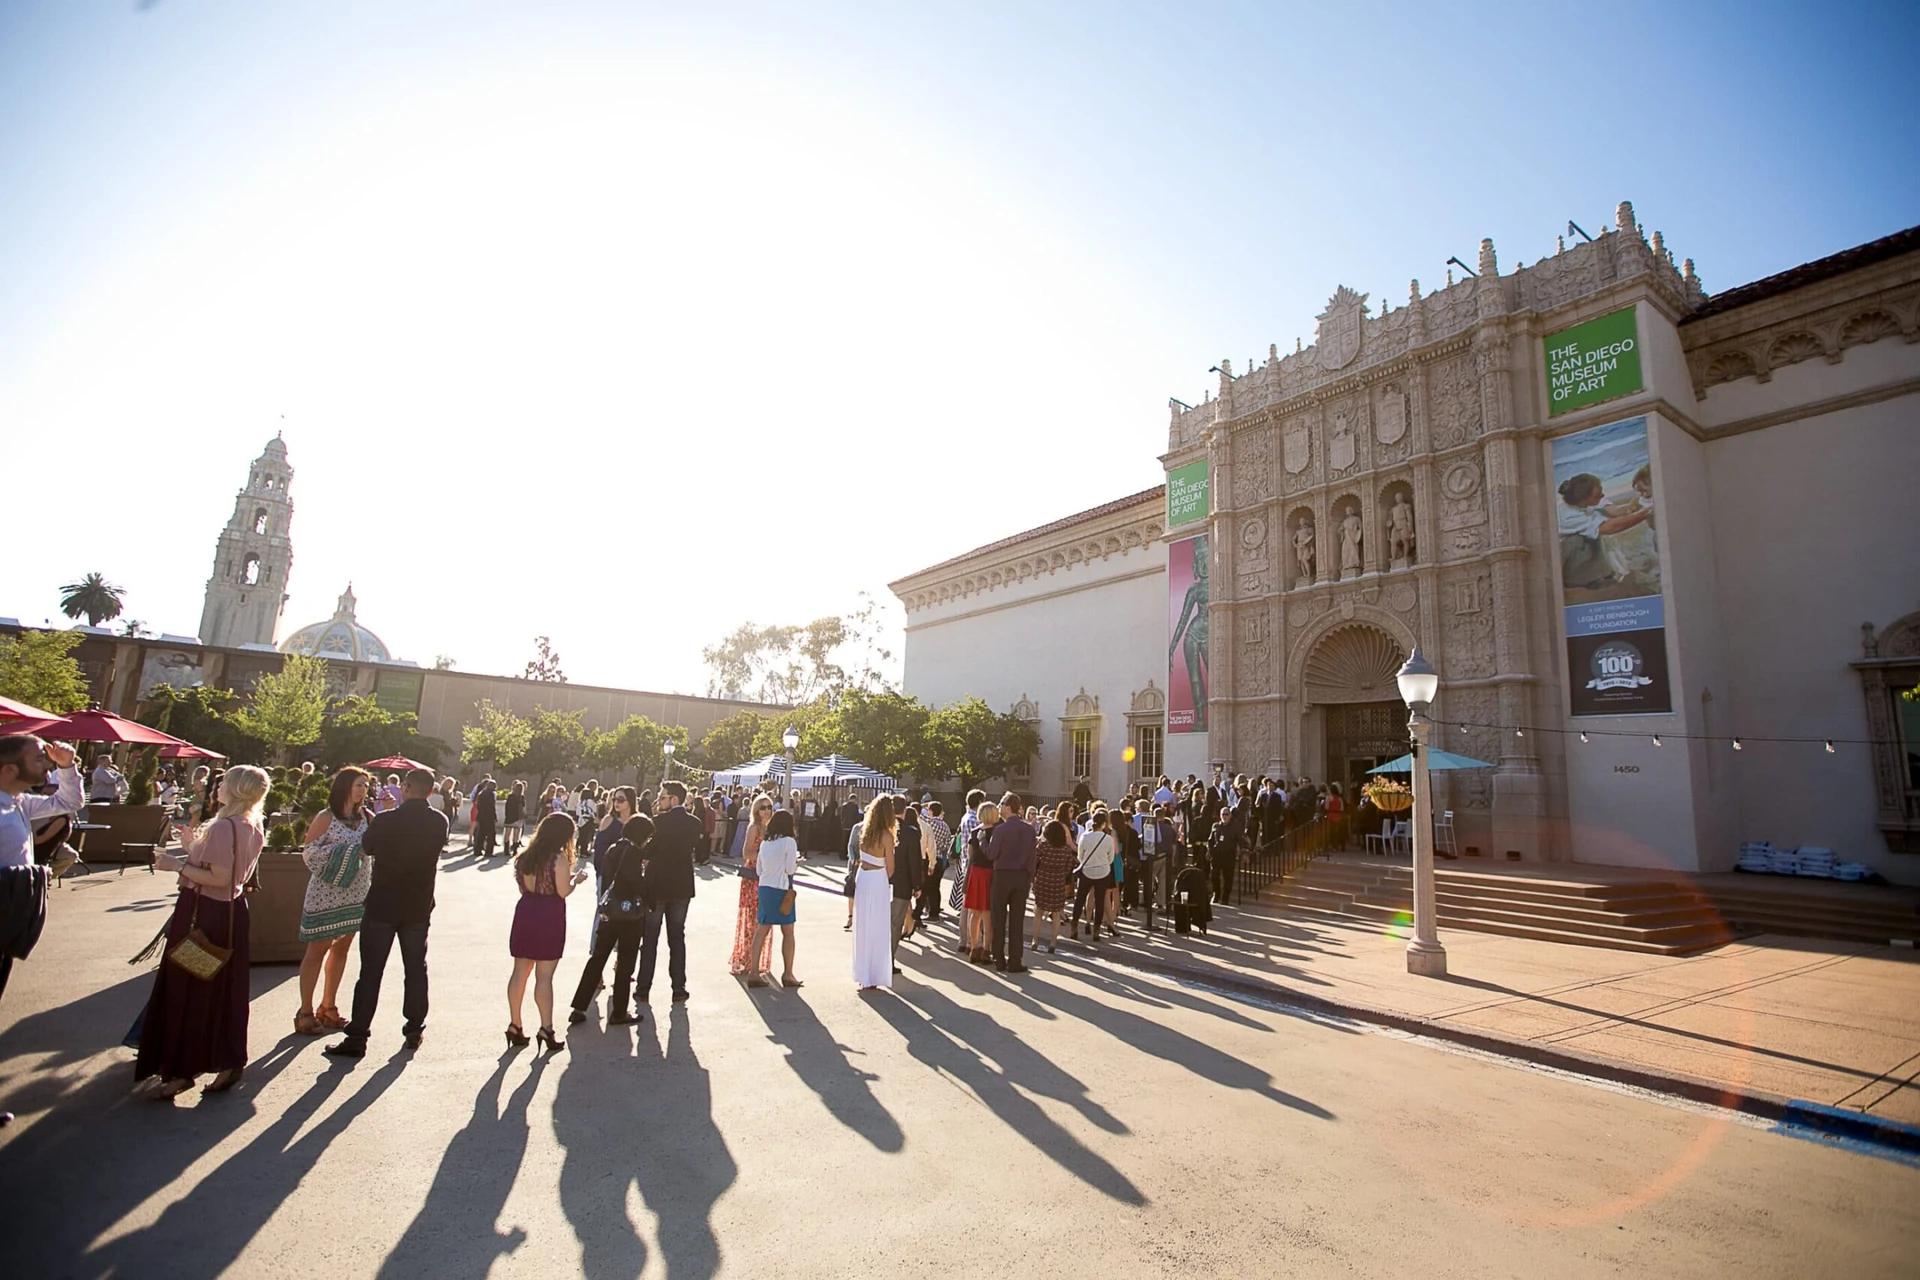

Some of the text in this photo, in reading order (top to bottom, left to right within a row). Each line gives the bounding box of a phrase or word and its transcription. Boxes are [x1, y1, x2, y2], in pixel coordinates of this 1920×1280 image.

[1549, 343, 1578, 360] THE
[1551, 339, 1633, 374] SAN DIEGO
[1552, 358, 1617, 388] MUSEUM
[1553, 375, 1607, 400] OF ART
[1171, 477, 1185, 488] THE
[1171, 487, 1186, 498] SAN
[1171, 491, 1202, 507] MUSEUM
[1171, 502, 1197, 516] OF ART
[1577, 609, 1650, 623] LEGLER BENBOUGH
[1589, 619, 1637, 630] FOUNDATION
[1598, 656, 1633, 673] 100
[1614, 765, 1640, 773] 1450
